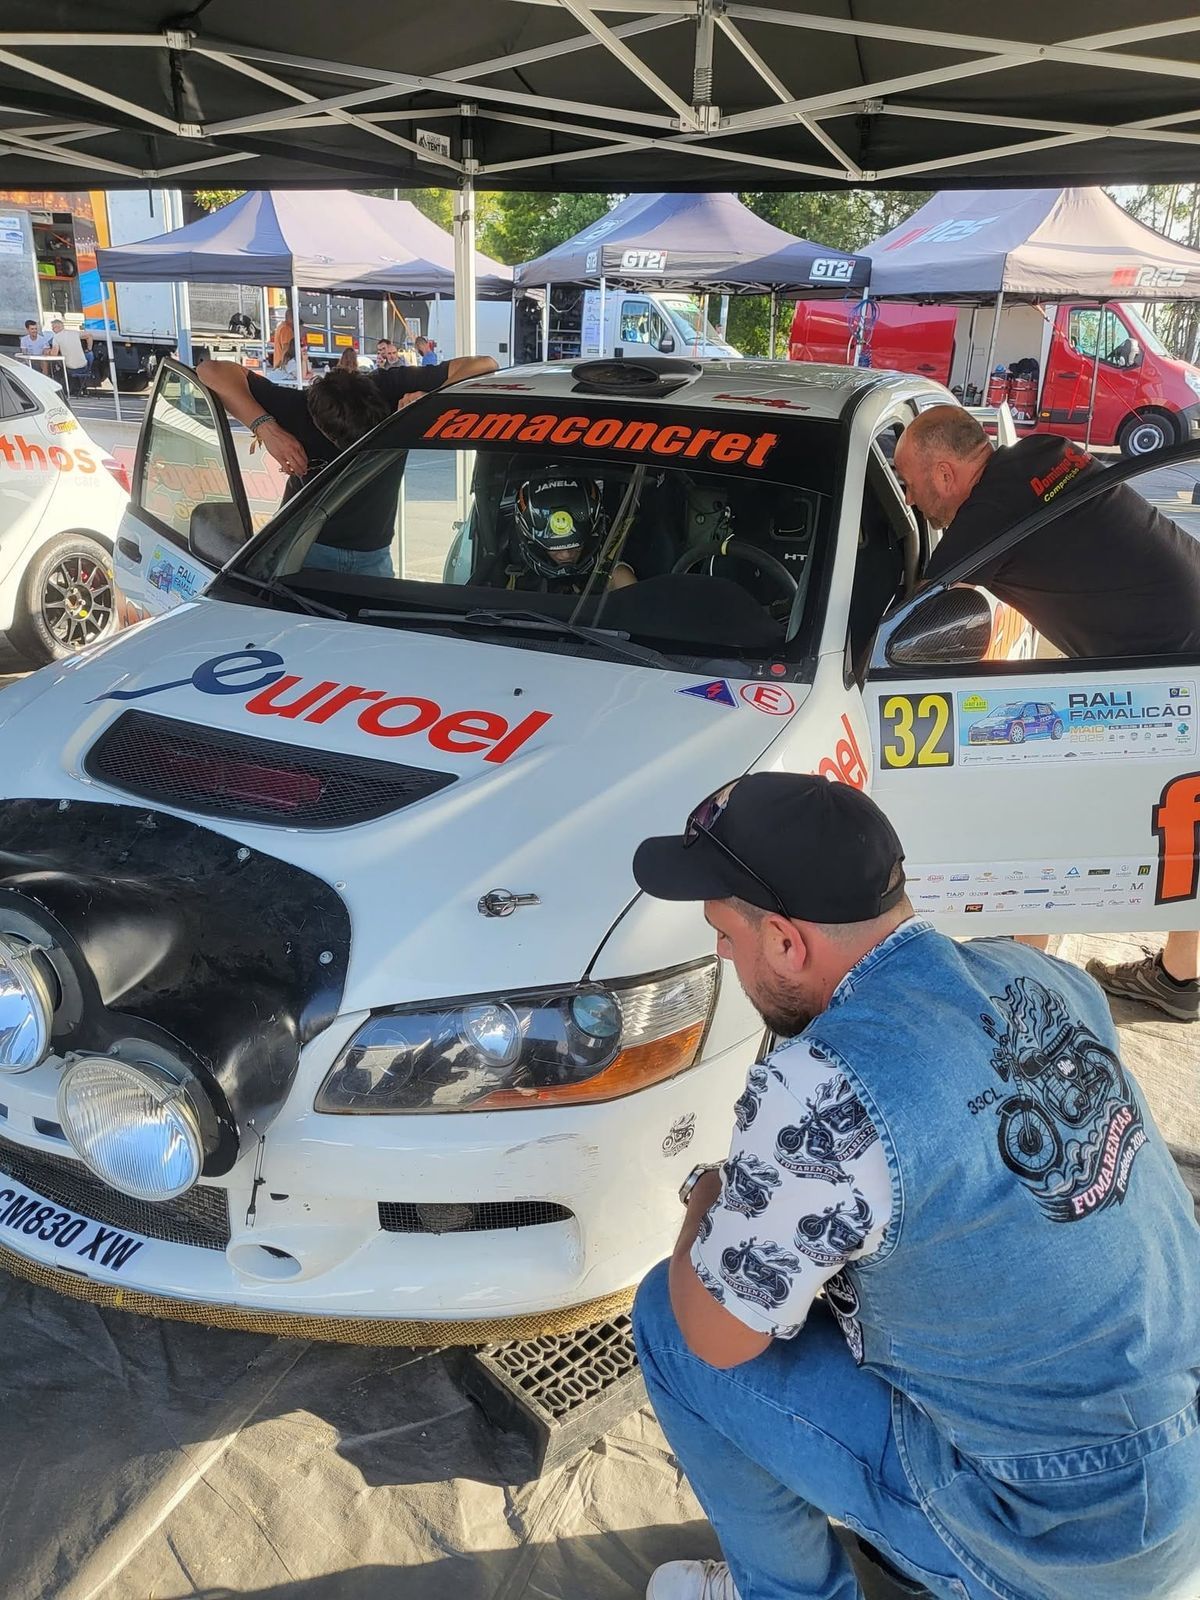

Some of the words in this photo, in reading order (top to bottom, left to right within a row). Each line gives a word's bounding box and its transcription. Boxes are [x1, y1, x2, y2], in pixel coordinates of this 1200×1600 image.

[422, 407, 778, 468] famaconcret
[534, 480, 578, 493] JANELA
[176, 564, 197, 584] RALI
[173, 577, 198, 598] FAMALIC
[190, 649, 553, 765] euroel
[753, 686, 783, 711] E
[1068, 691, 1133, 708] RALI
[1069, 703, 1192, 721] FAMALICÃO
[884, 694, 949, 767] 32
[1070, 725, 1105, 735] MAIO
[1070, 734, 1105, 743] 2025
[811, 713, 869, 791] oel
[837, 1125, 876, 1161] UMARENTA
[779, 1159, 839, 1178] FUMARENTAS
[1071, 1106, 1133, 1215] FUMARENTAS
[76, 1226, 144, 1272] XW
[799, 1246, 849, 1263] FUMAREN
